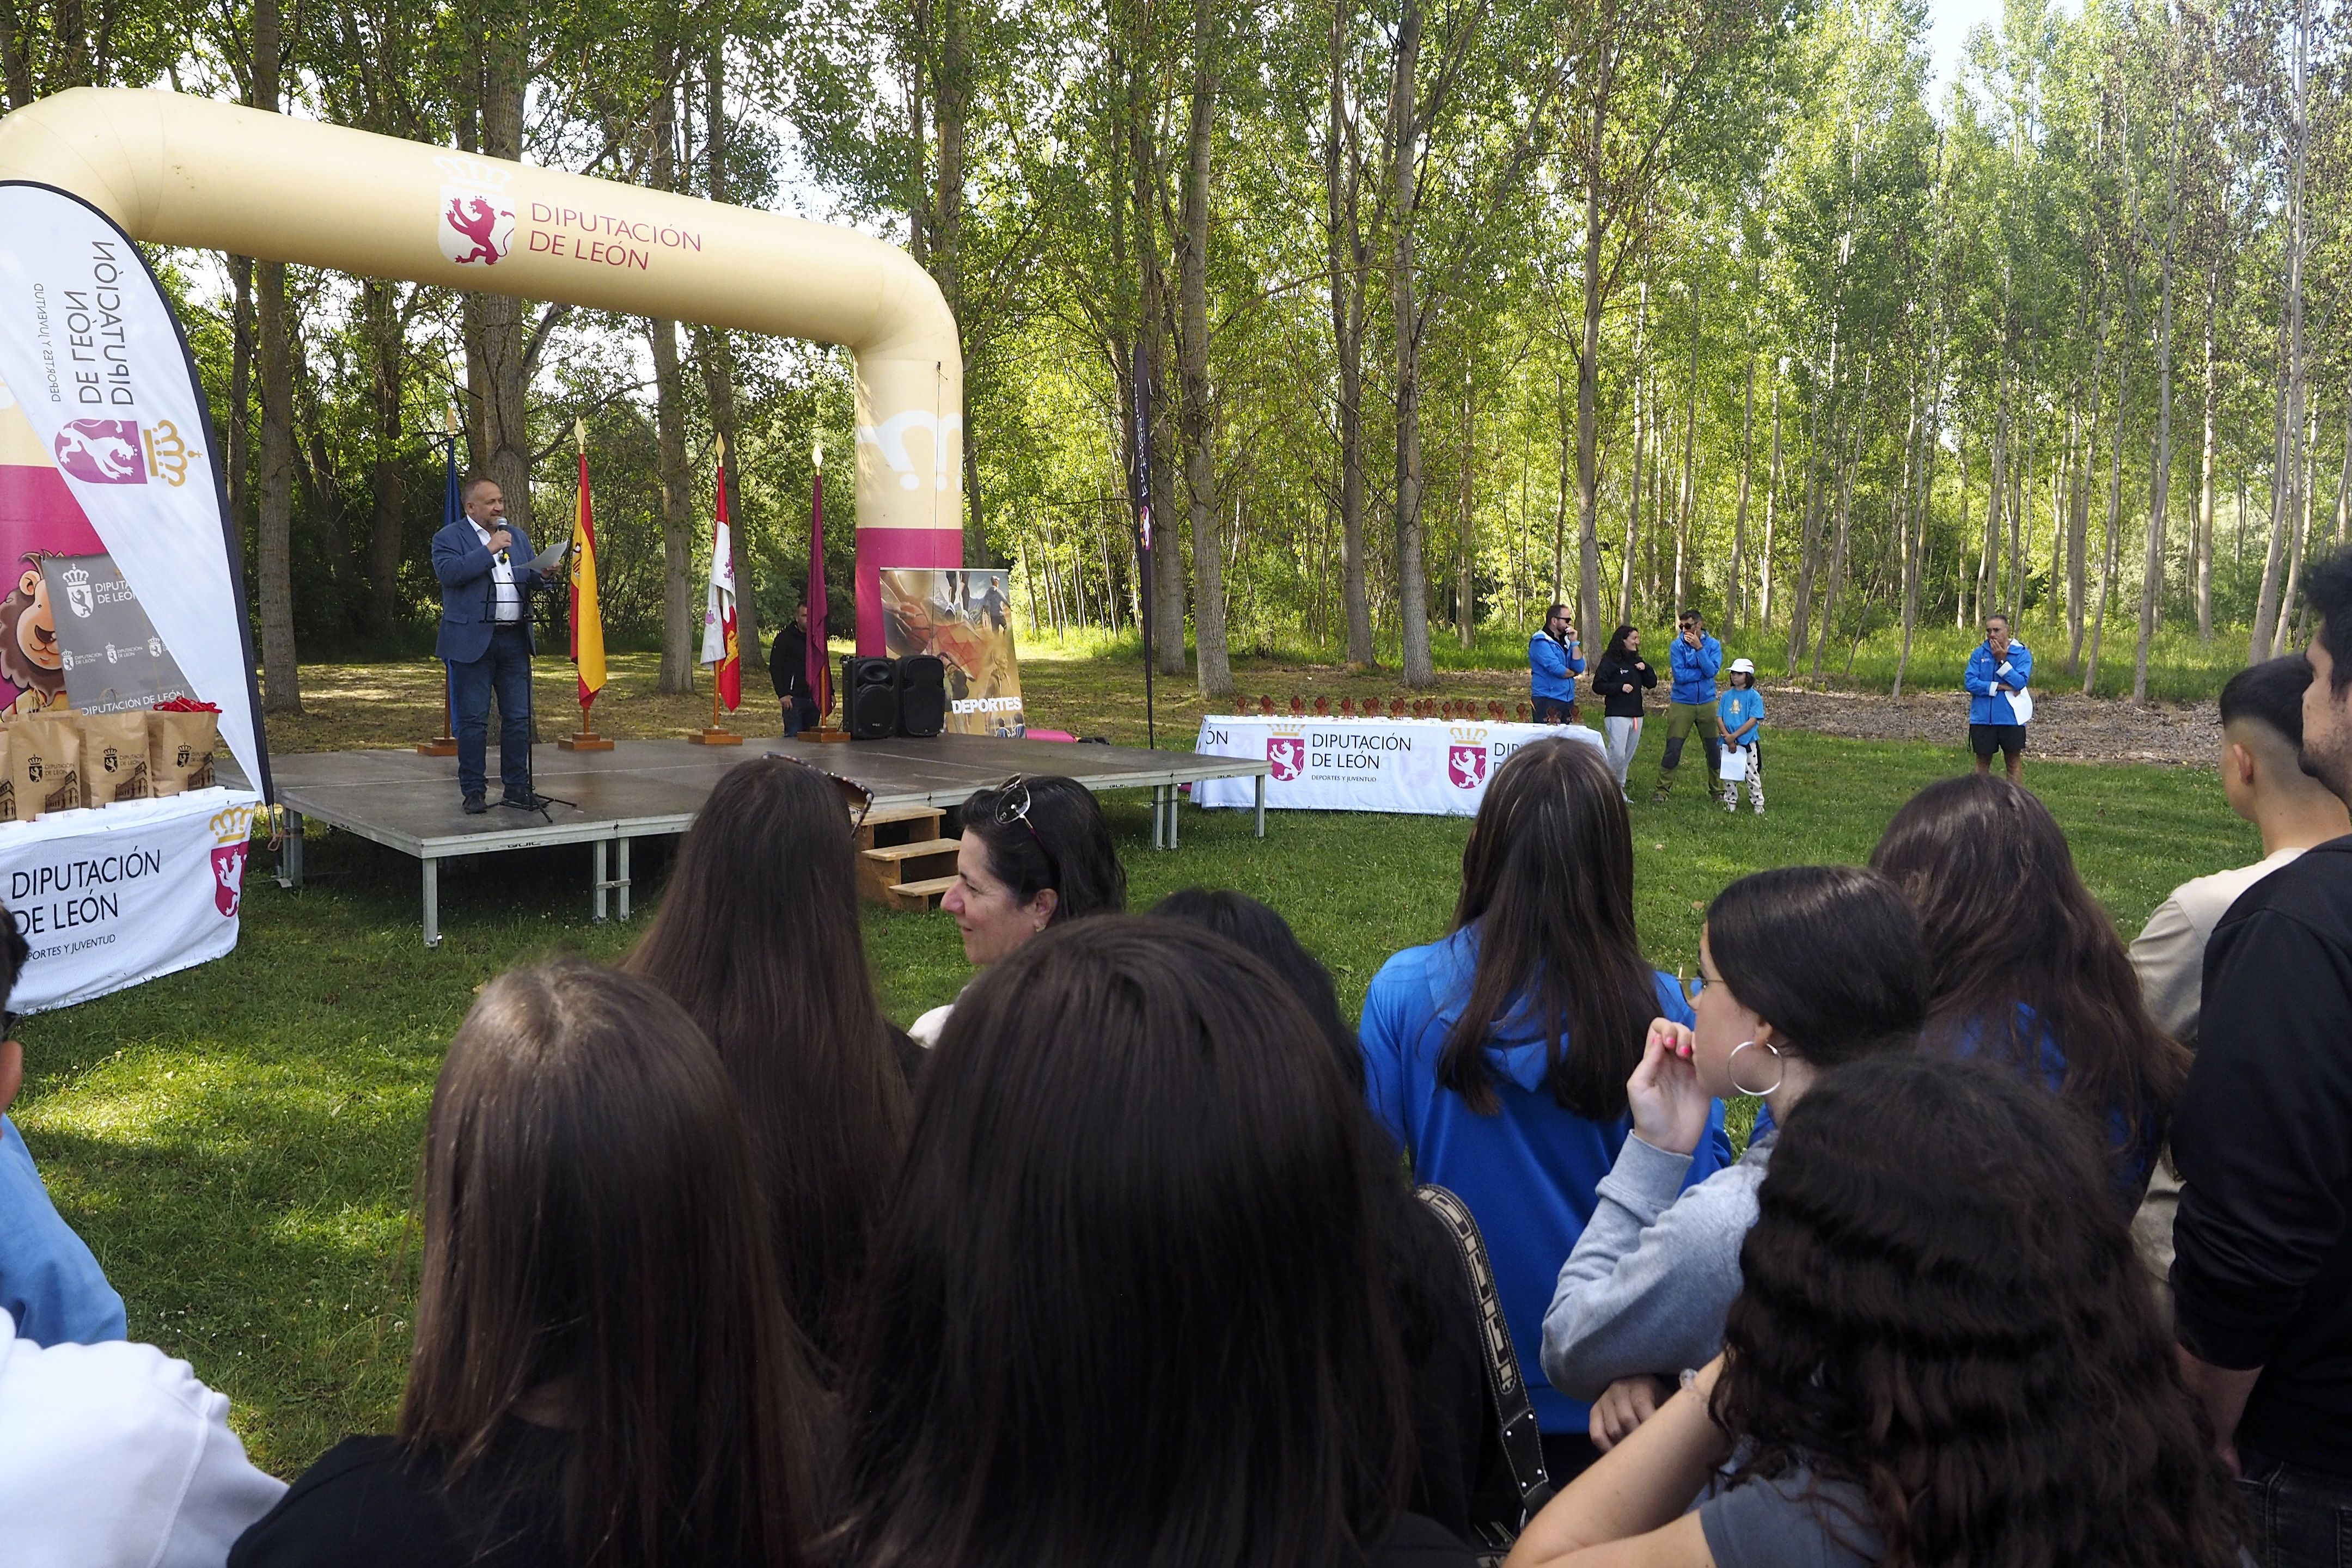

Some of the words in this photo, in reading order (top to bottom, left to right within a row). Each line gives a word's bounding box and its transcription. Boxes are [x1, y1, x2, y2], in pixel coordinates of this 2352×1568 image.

[532, 203, 701, 252] DIPUTACIÓN
[529, 230, 566, 256] DE
[575, 239, 649, 270] LEÓN
[97, 594, 111, 604] DE
[82, 697, 141, 716] DIPUTACIÓN
[143, 695, 155, 705] DE
[951, 697, 1022, 714] DEPORTES
[1312, 732, 1411, 751] DIPUTACIÓN
[1312, 753, 1331, 767] DE
[1337, 750, 1379, 769] LEÓN
[12, 846, 160, 899] DIPUTACIÓN
[12, 906, 45, 936] DE
[54, 889, 118, 929] LEÓN
[27, 946, 61, 961] PORTES
[64, 944, 70, 953] Y
[71, 934, 116, 954] JUVENTUD
